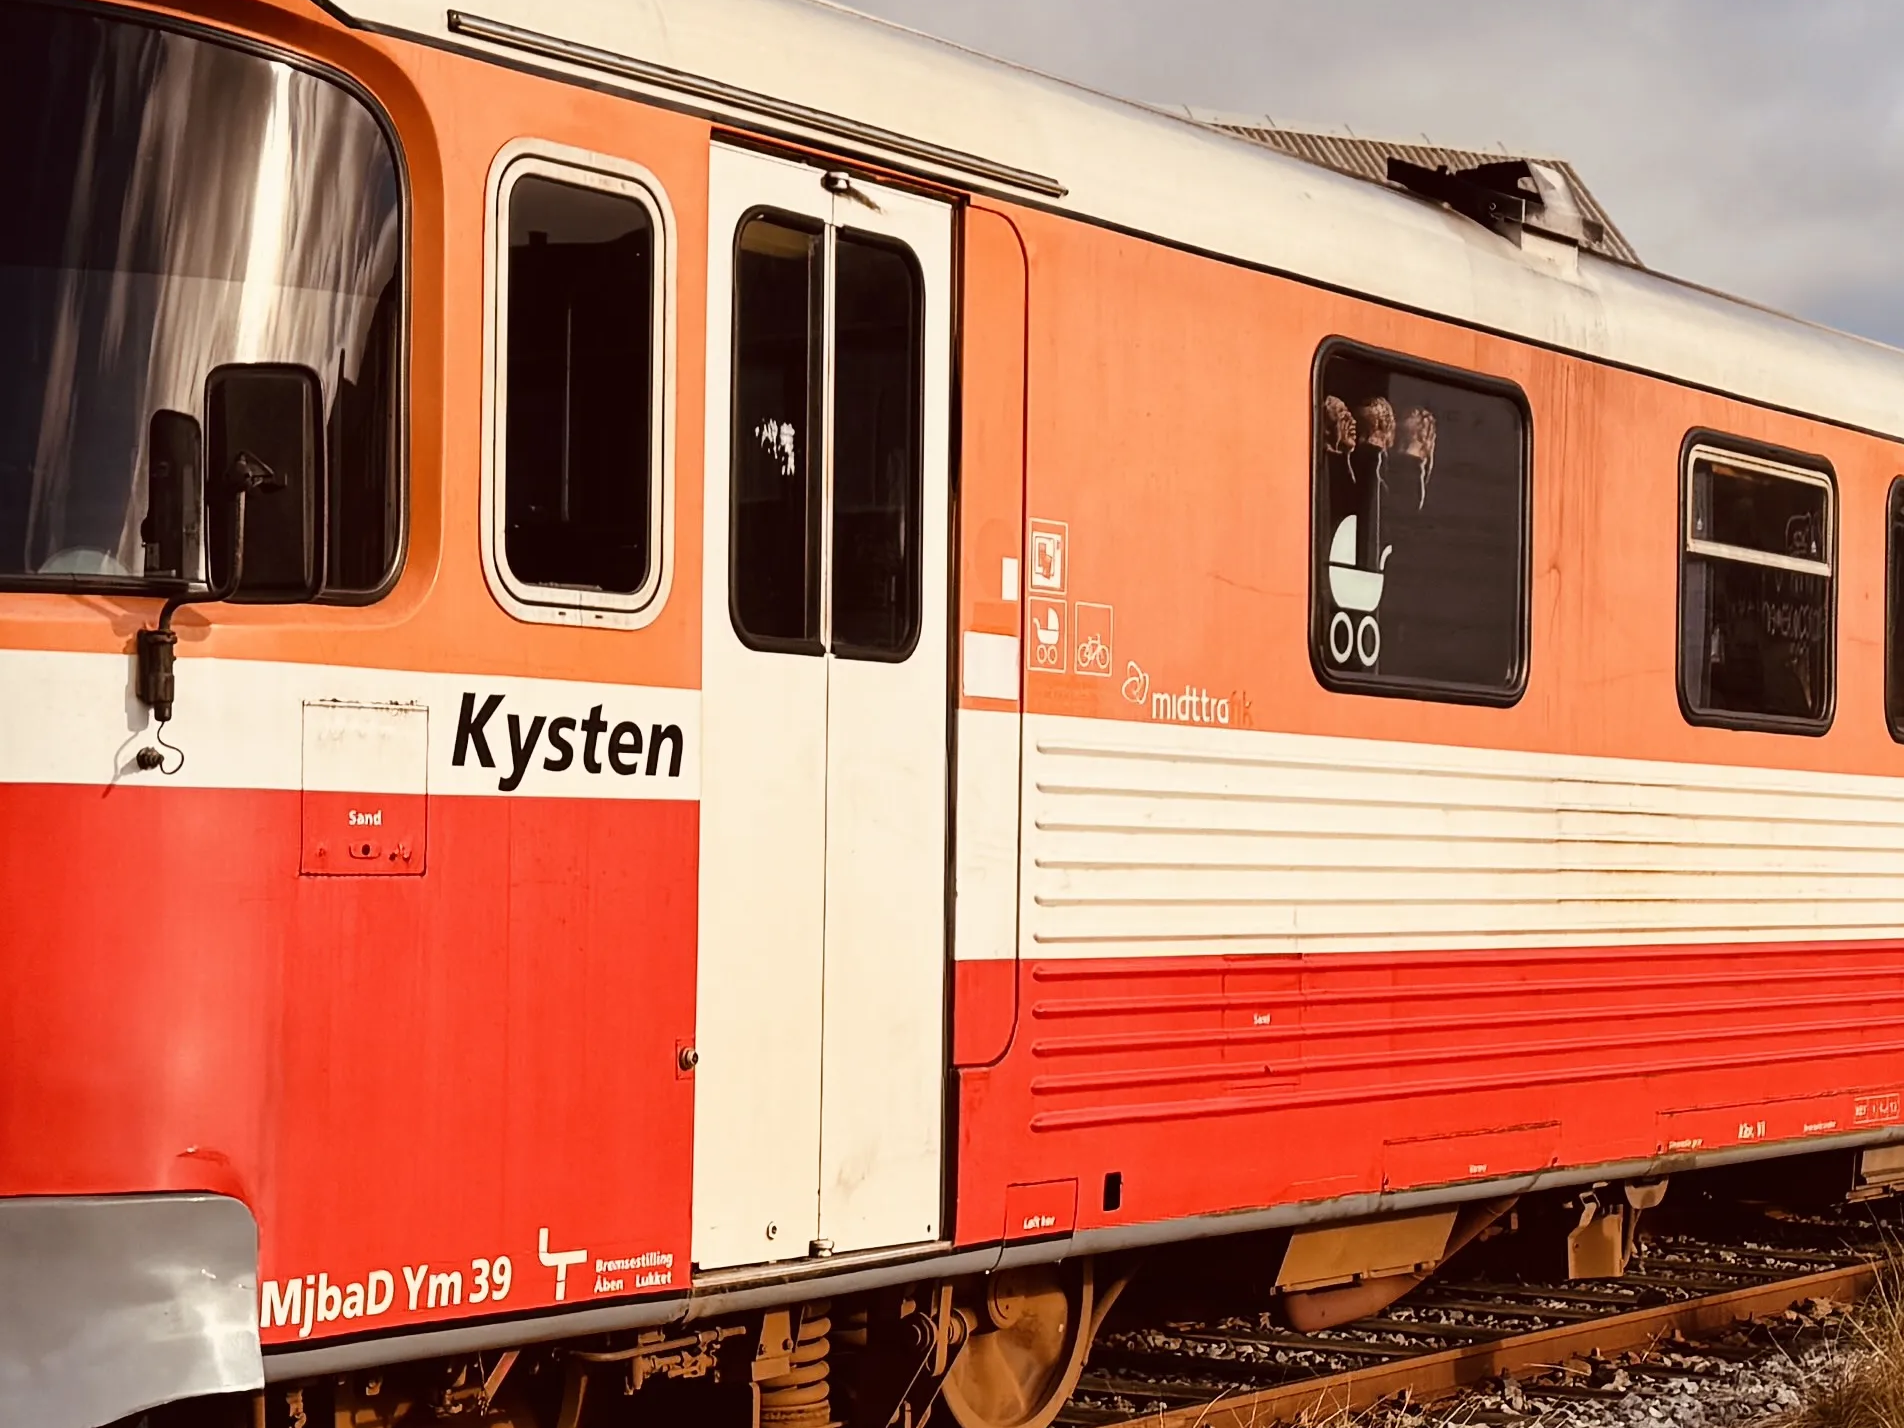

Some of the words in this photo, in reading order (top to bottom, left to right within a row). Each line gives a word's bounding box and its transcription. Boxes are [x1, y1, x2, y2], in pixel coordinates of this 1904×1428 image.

[452, 692, 684, 792] Kysten
[348, 809, 382, 826] Sand
[260, 1269, 394, 1338] MjbaD
[402, 1264, 463, 1310] Ym
[469, 1255, 512, 1303] 39
[594, 1274, 624, 1293] Åben
[636, 1271, 672, 1288] Lukket
